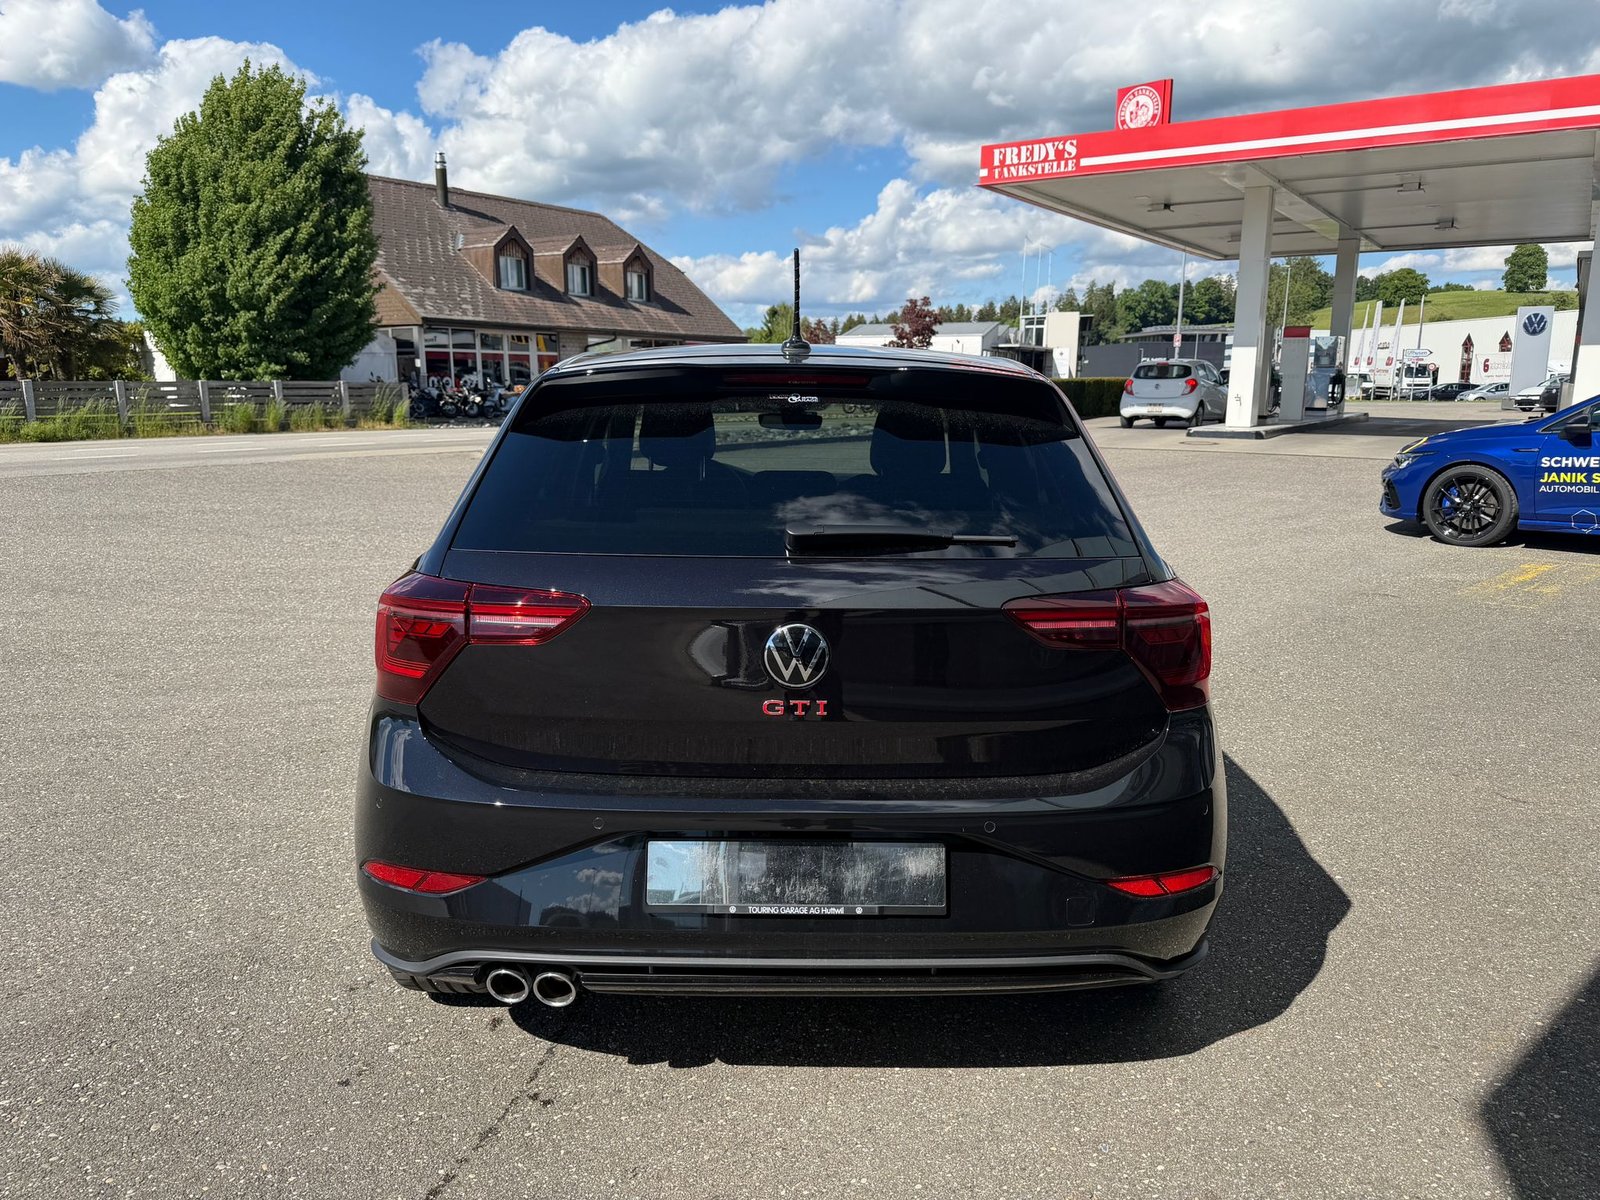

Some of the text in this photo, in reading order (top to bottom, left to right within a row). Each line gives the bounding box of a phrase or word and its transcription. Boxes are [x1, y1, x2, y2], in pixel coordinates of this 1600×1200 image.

[993, 159, 1076, 179] TANKSTELLE
[1540, 456, 1600, 468] SCHWE
[1540, 472, 1588, 483] JANIK
[1539, 485, 1599, 493] AUTOMOBIL
[762, 699, 828, 716] GTI
[748, 906, 779, 914] TOURING
[780, 906, 808, 914] GARAGE
[809, 907, 821, 915] AG
